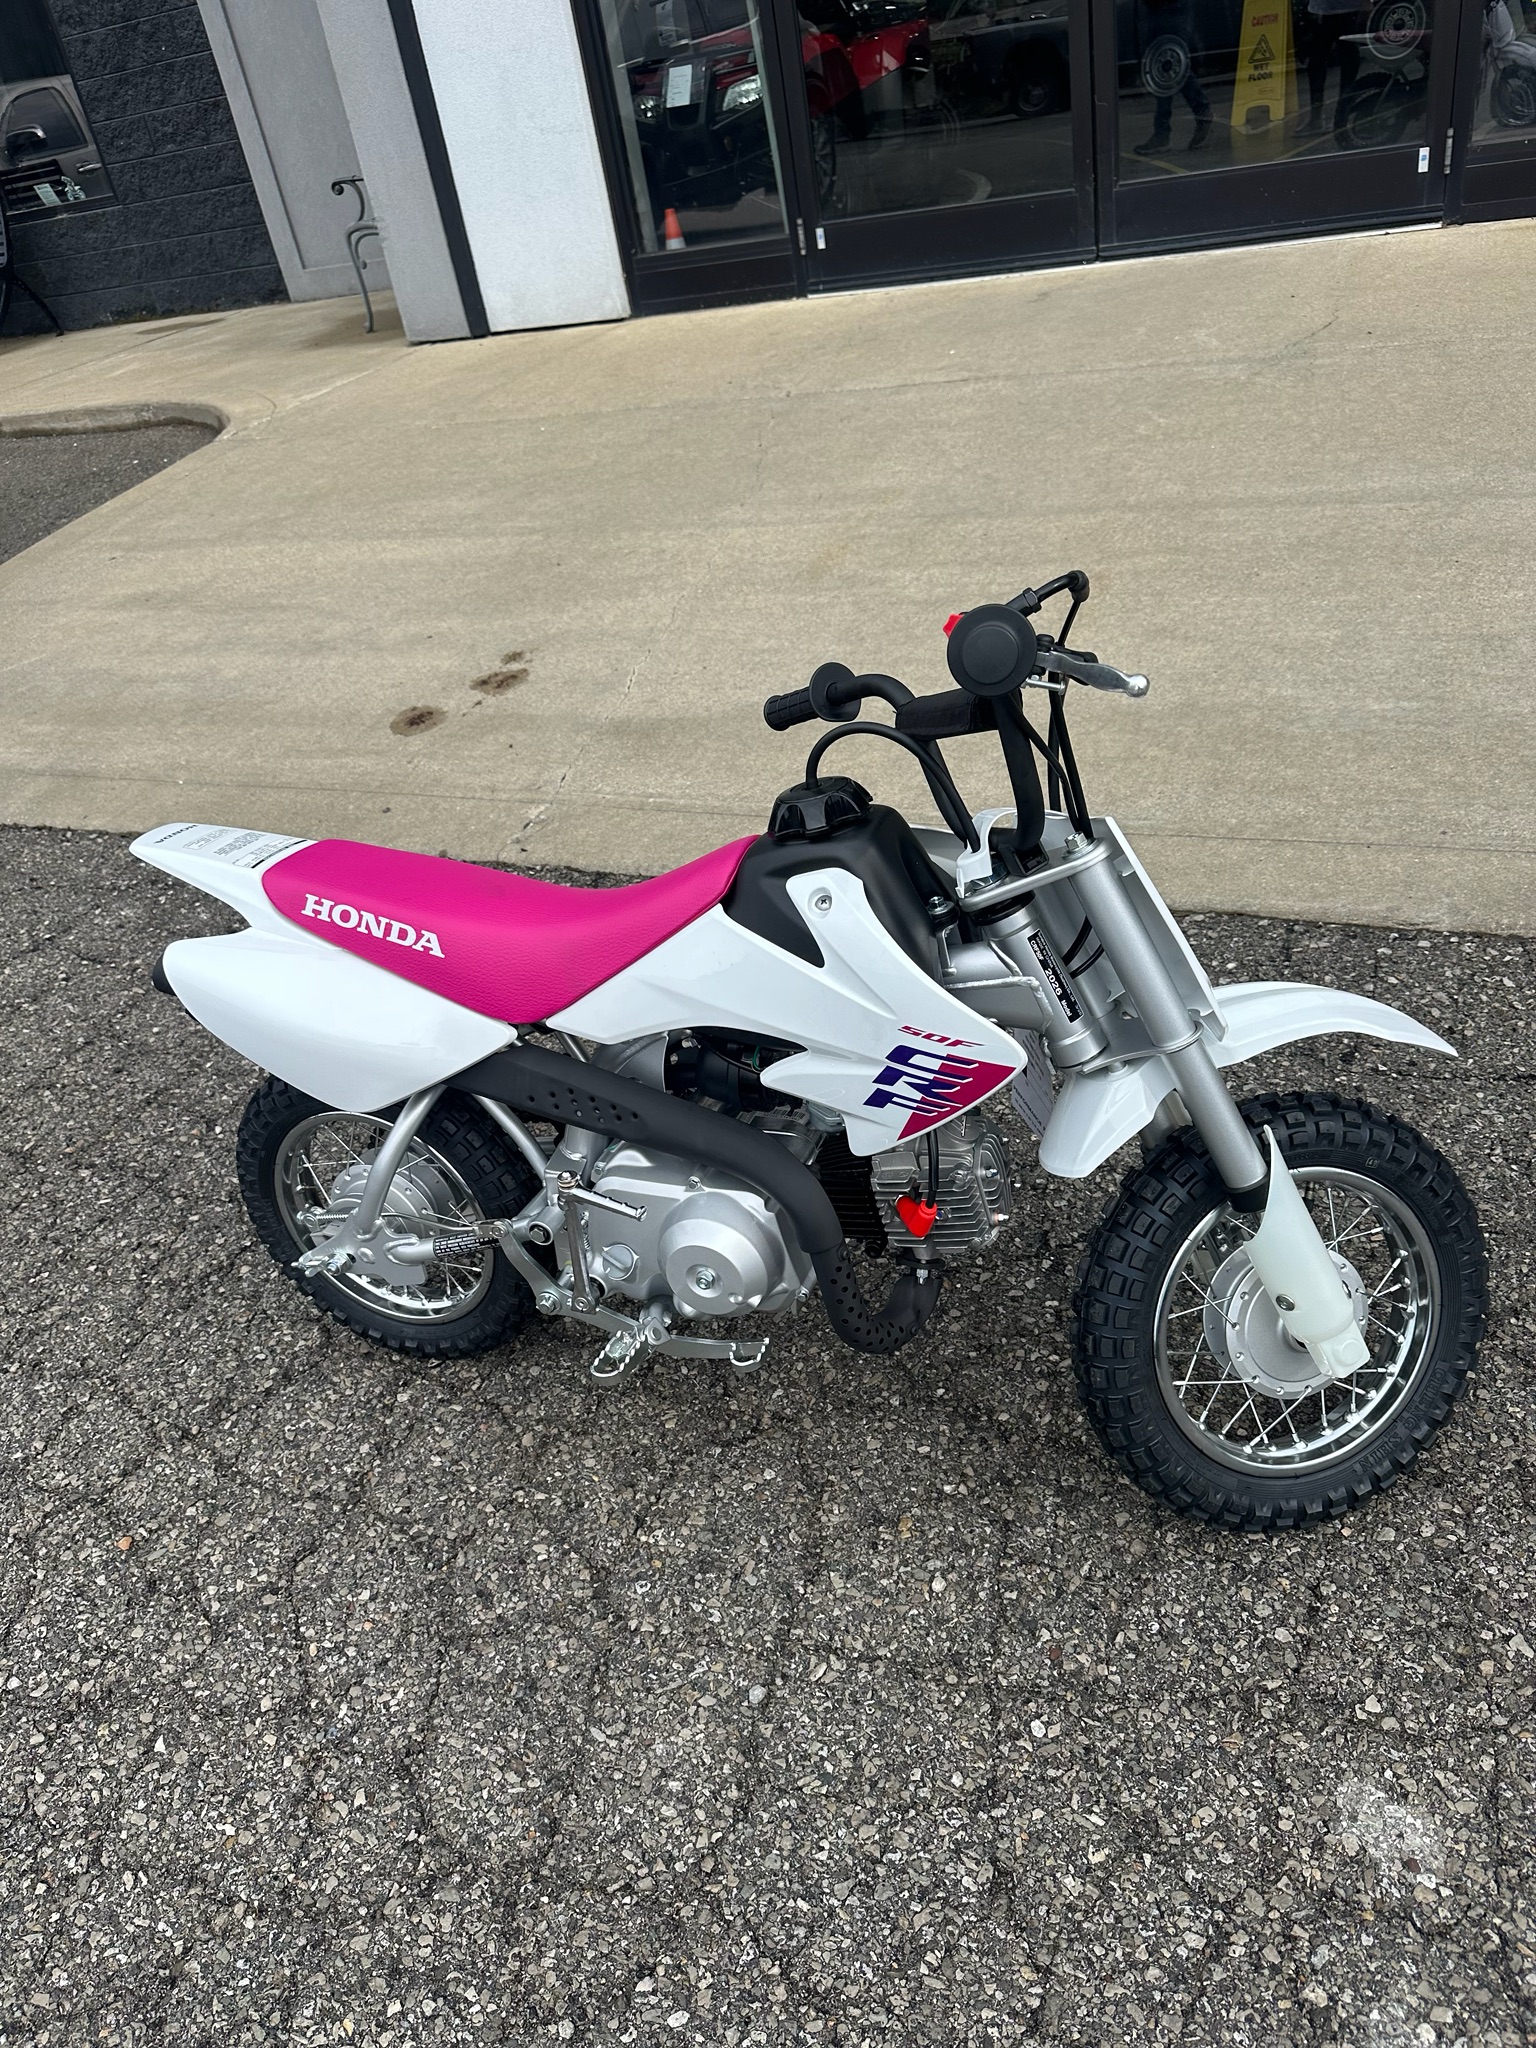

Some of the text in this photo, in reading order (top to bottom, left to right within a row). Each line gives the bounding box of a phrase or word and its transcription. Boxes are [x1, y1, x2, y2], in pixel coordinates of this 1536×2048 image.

[1252, 13, 1279, 27] CAUTION
[1248, 71, 1273, 82] FLOOR
[301, 893, 445, 958] HONDA
[1030, 940, 1044, 961] CRF50F
[1044, 967, 1063, 996] 2026
[1061, 999, 1073, 1017] Model
[897, 1025, 986, 1047] 50F
[862, 1044, 979, 1117] CRF
[1359, 1367, 1446, 1471] CHENG SHIN
